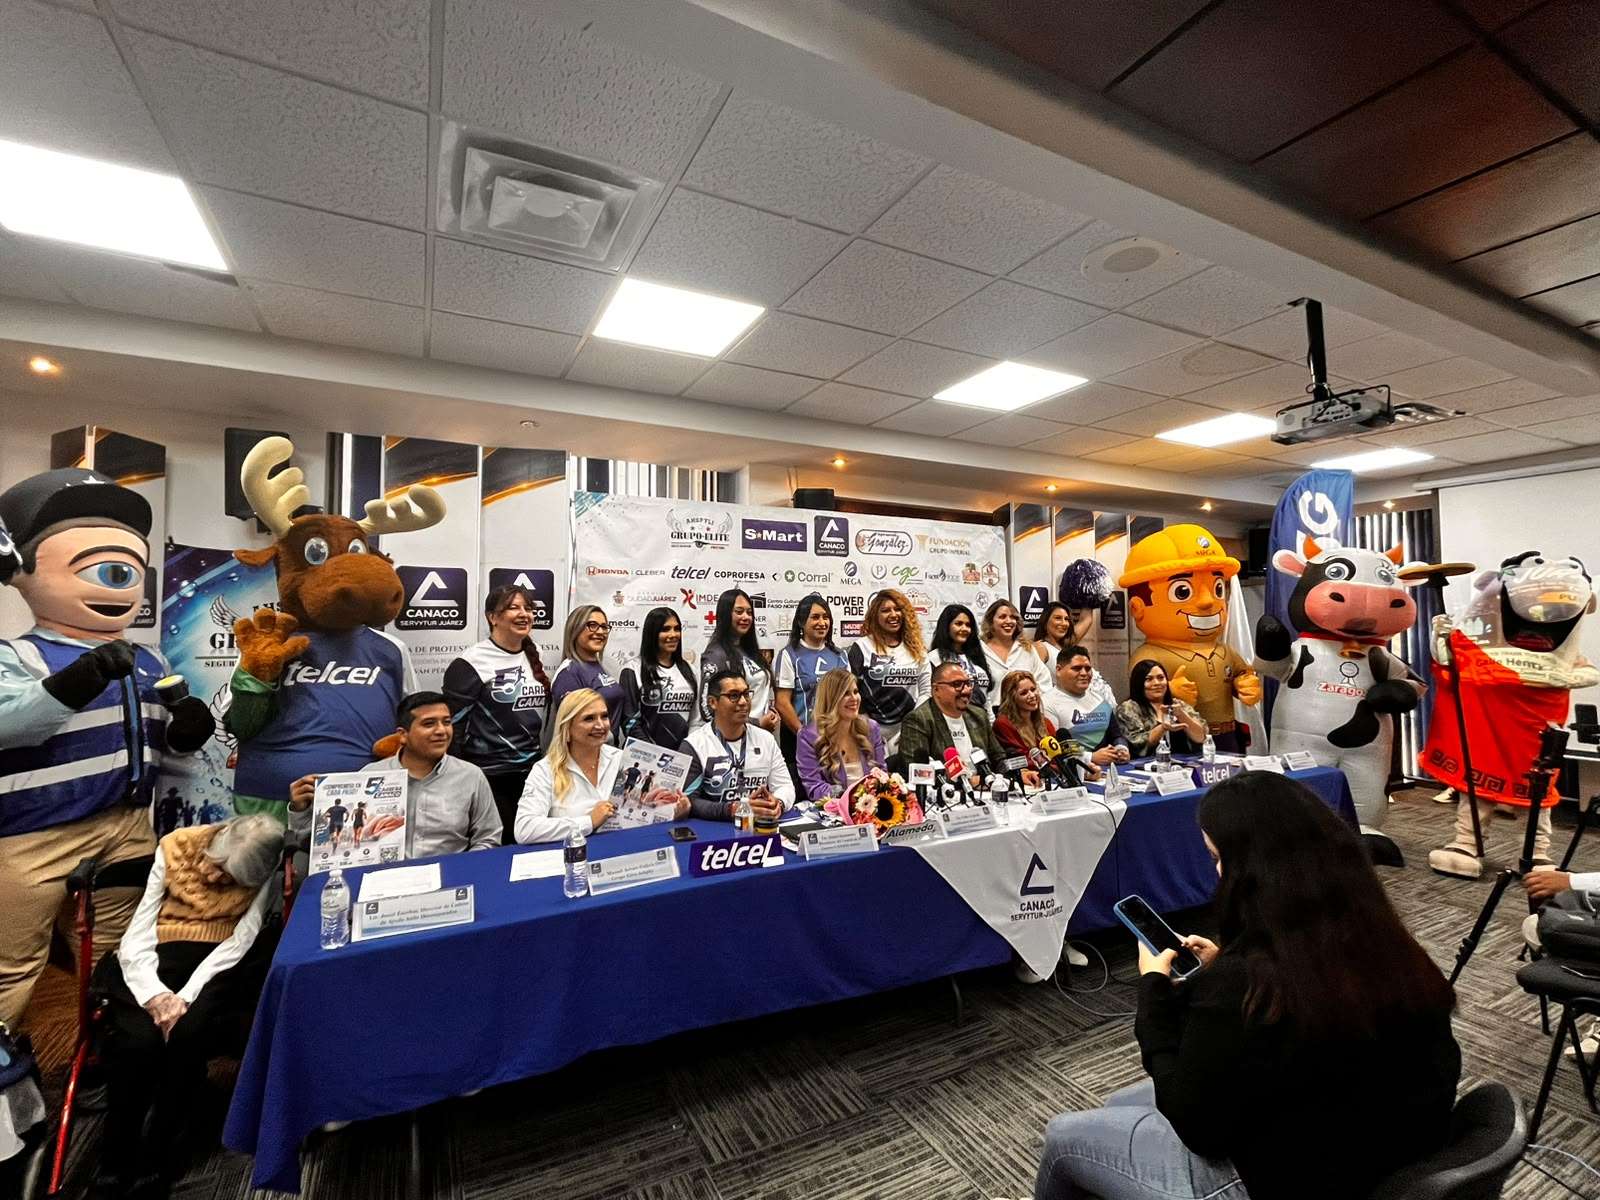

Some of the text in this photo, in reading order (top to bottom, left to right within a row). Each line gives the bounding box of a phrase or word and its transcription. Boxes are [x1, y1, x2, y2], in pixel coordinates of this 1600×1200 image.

[818, 542, 846, 550] CANACO
[671, 565, 711, 580] telcel
[714, 570, 766, 579] COPROFESA
[797, 571, 831, 583] Corral
[839, 577, 862, 586] MEGA
[827, 596, 864, 606] POWER
[406, 609, 459, 618] CANACO
[843, 606, 864, 616] ADE
[608, 619, 635, 627] meda
[283, 660, 381, 687] telcel
[1318, 681, 1364, 697] Zarago
[1048, 738, 1059, 751] 6
[1202, 764, 1231, 784] telcel
[886, 823, 934, 839] Alameda
[700, 837, 774, 872] telcel
[1020, 898, 1055, 912] CANACO
